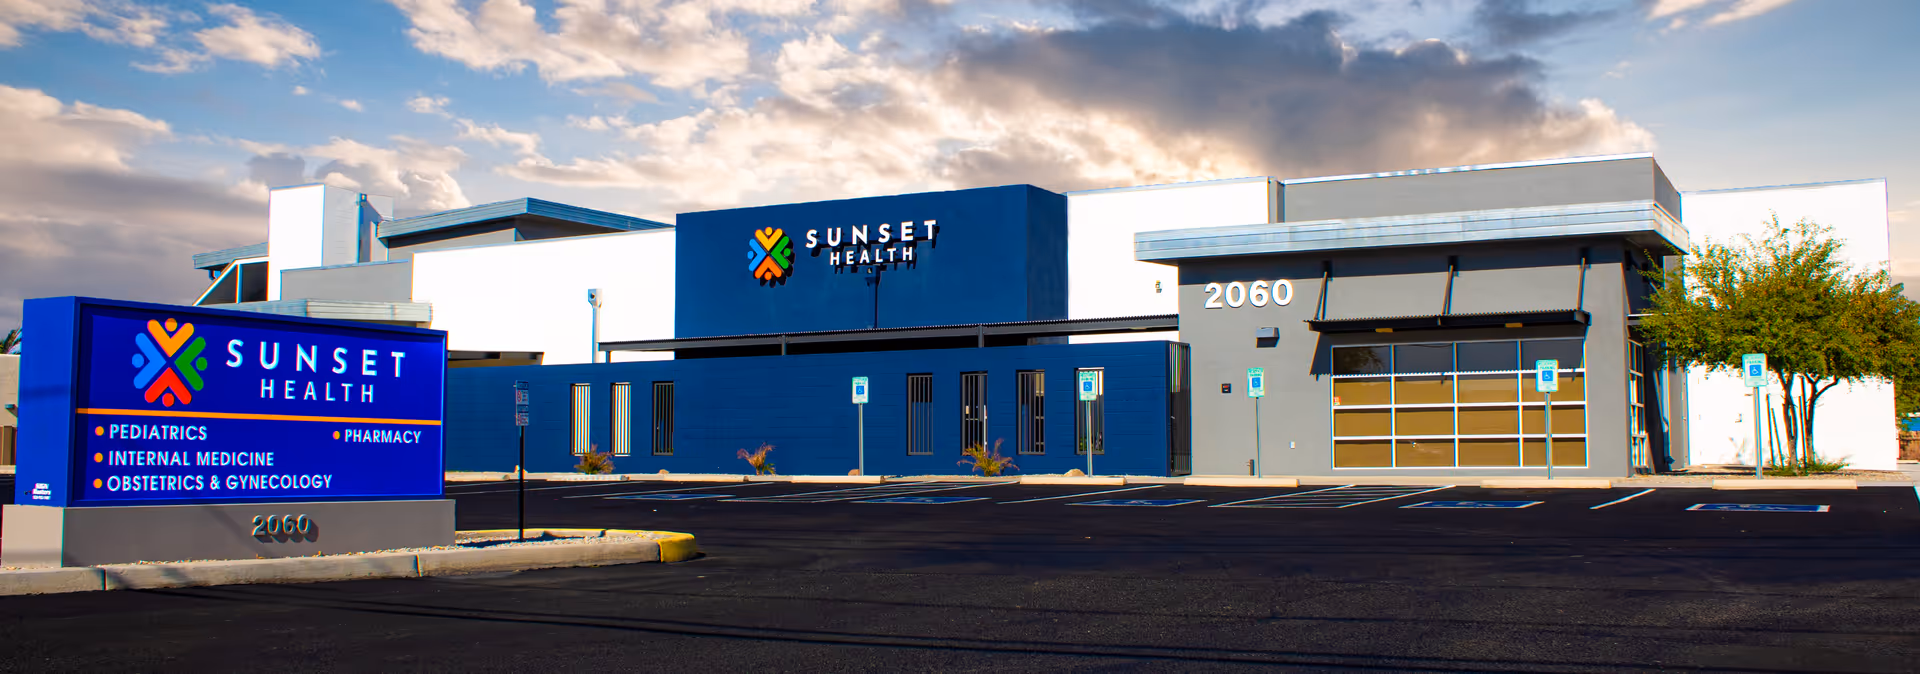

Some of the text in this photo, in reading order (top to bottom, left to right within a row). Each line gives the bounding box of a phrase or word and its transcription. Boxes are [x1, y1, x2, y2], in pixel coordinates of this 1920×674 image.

[805, 220, 936, 248] SUNSET
[829, 246, 913, 266] HEALTH
[1204, 279, 1293, 309] 2060
[225, 338, 406, 378] SUNSET
[260, 378, 375, 403] HEALTH
[109, 423, 208, 441] PEDIATRICS
[344, 428, 422, 444] PHARMACY
[108, 450, 275, 467] INTERNAL MEDICINE
[107, 474, 333, 492] OBSTETRICS & GYNECOLOGY
[251, 514, 311, 536] 2060
